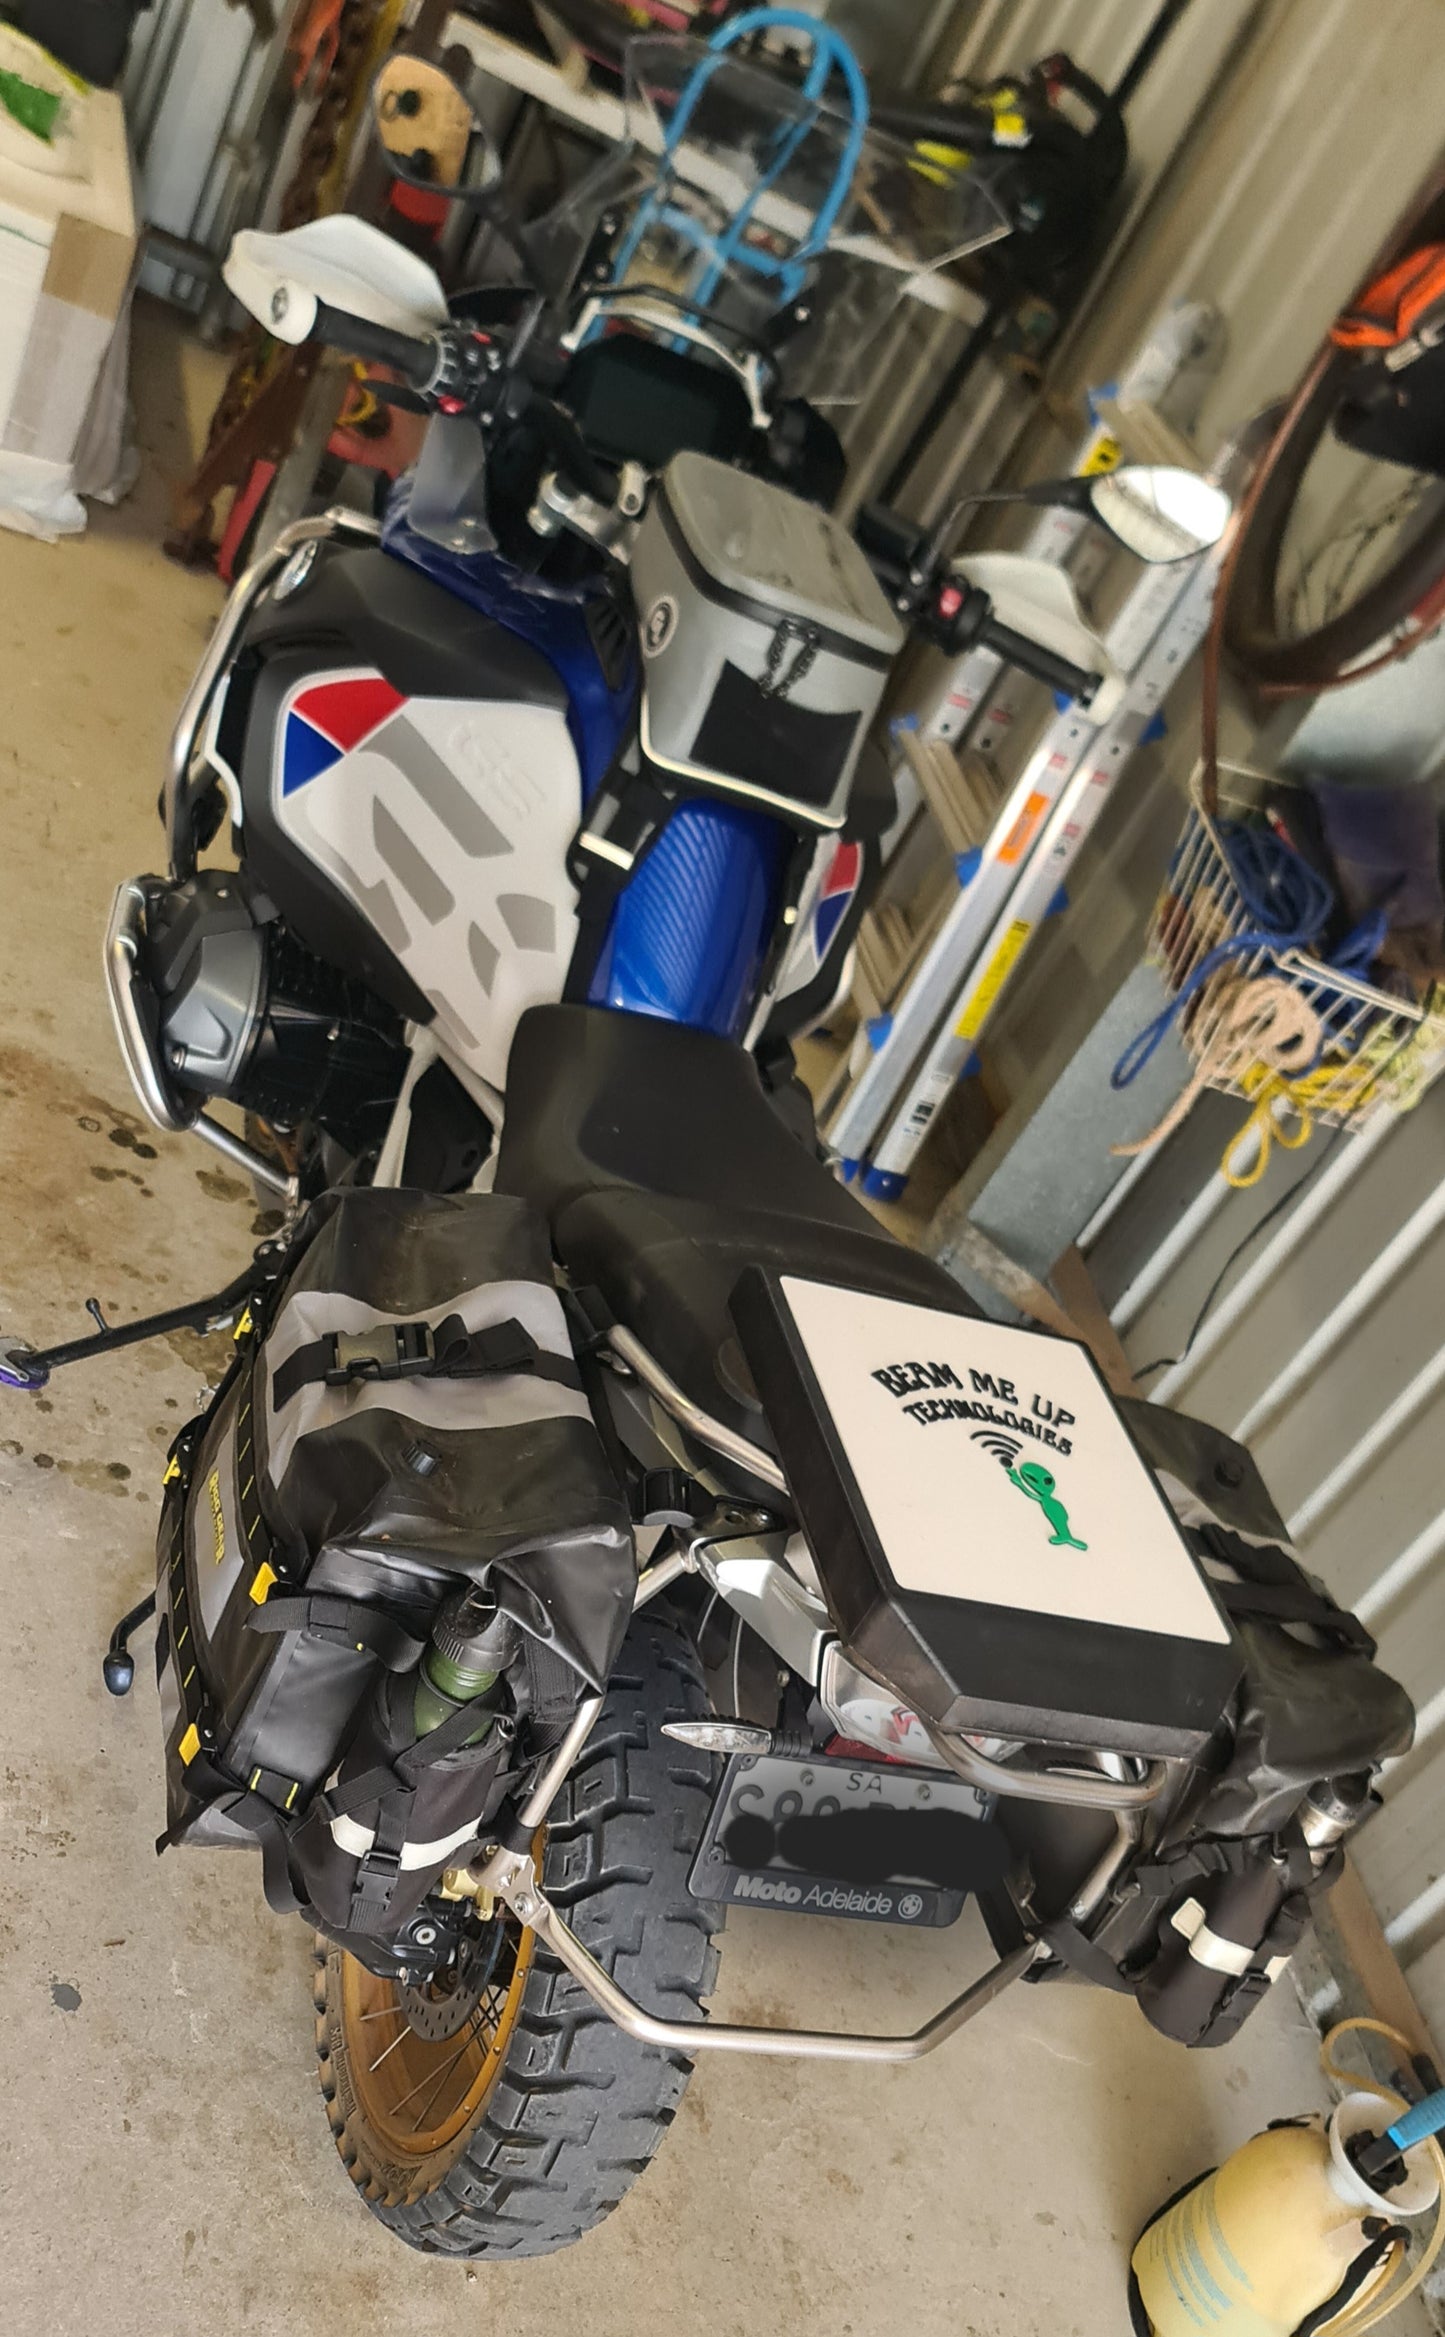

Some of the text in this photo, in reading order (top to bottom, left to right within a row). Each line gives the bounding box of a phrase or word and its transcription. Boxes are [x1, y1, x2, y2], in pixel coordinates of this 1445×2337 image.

[871, 1361, 1076, 1428] BEAM ME UP
[902, 1399, 1073, 1457] TECHNOLOGIES
[846, 1771, 883, 1794] SA
[733, 1875, 893, 1916] Moto Adelaide
